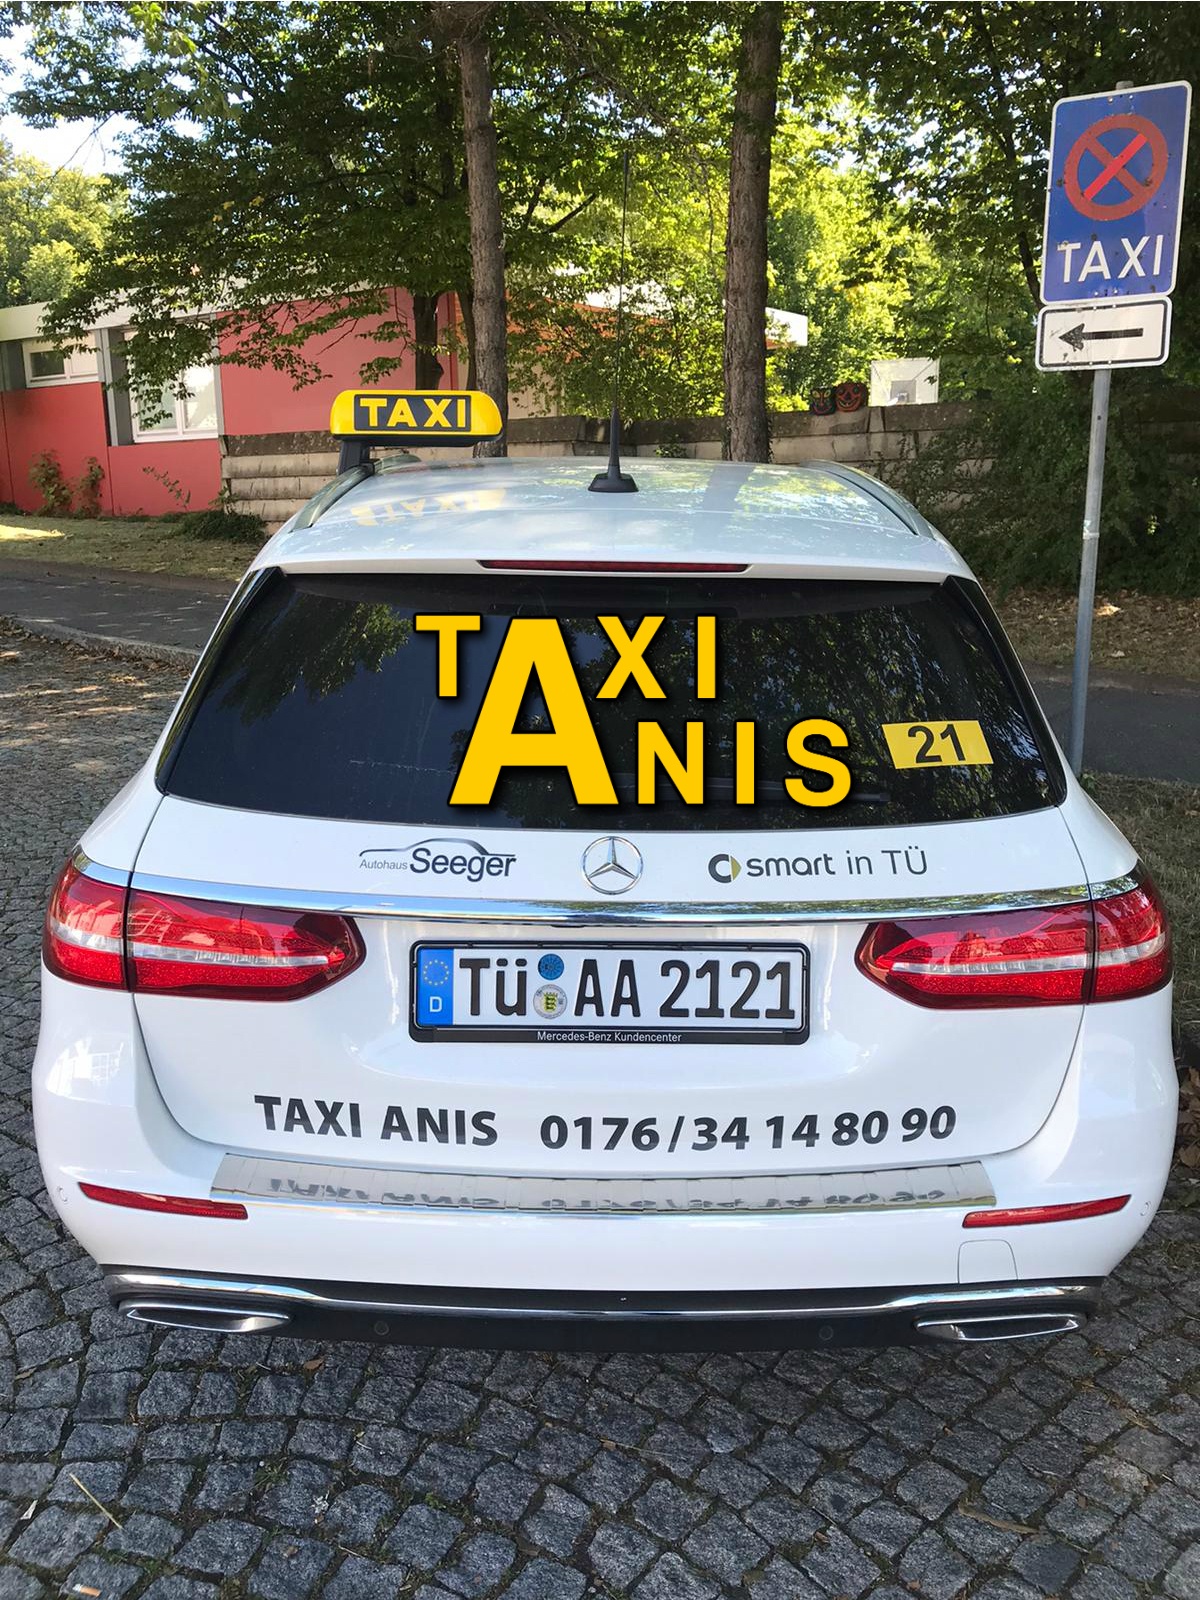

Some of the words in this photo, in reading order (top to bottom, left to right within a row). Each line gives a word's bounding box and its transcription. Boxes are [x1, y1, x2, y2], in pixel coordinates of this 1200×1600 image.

[1057, 235, 1164, 283] TAXI
[359, 398, 466, 428] TAXI
[907, 724, 966, 763] 21
[359, 859, 408, 870] Autohaus
[409, 847, 517, 882] Seeger
[746, 853, 836, 876] smart
[846, 850, 873, 875] in
[881, 846, 928, 875] TÜ
[429, 996, 443, 1012] D
[574, 959, 641, 1017] AA
[659, 960, 795, 1019] 2121
[537, 1031, 612, 1042] Mercedes-Benz
[614, 1032, 682, 1042] Kundencenter
[254, 1095, 362, 1138] TAXI
[380, 1105, 498, 1146] ANIS
[765, 1115, 820, 1149] 14
[832, 1110, 889, 1147] 80
[901, 1105, 957, 1142] 90
